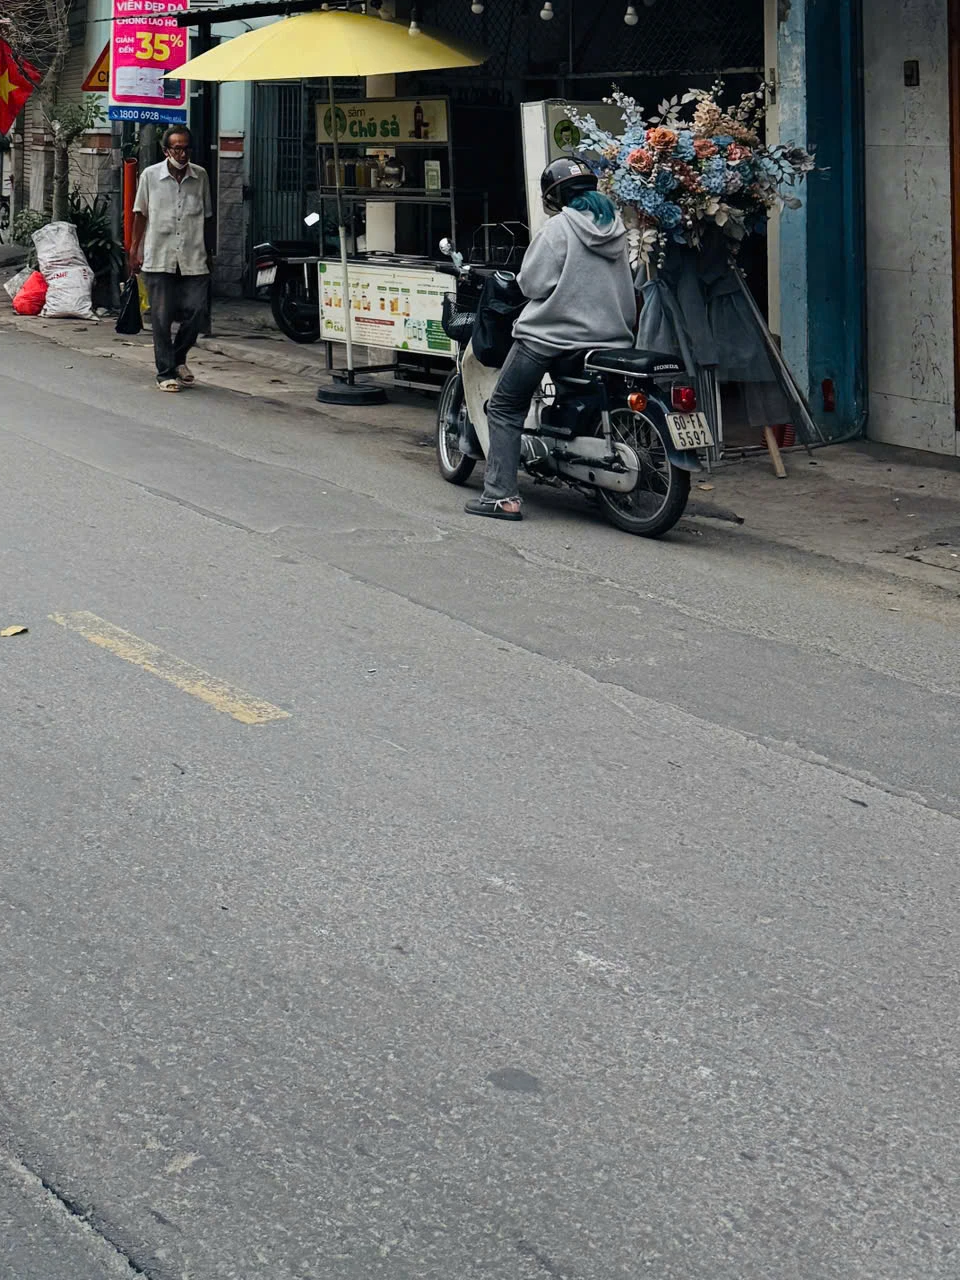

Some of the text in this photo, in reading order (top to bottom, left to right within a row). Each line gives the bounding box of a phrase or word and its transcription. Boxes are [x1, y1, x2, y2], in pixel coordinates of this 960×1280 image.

[116, 0, 142, 11] VIÊN
[167, 3, 184, 12] DA
[119, 109, 139, 119] 1800
[140, 110, 160, 120] 6928
[349, 117, 378, 138] Chú
[678, 430, 709, 447] 5592
